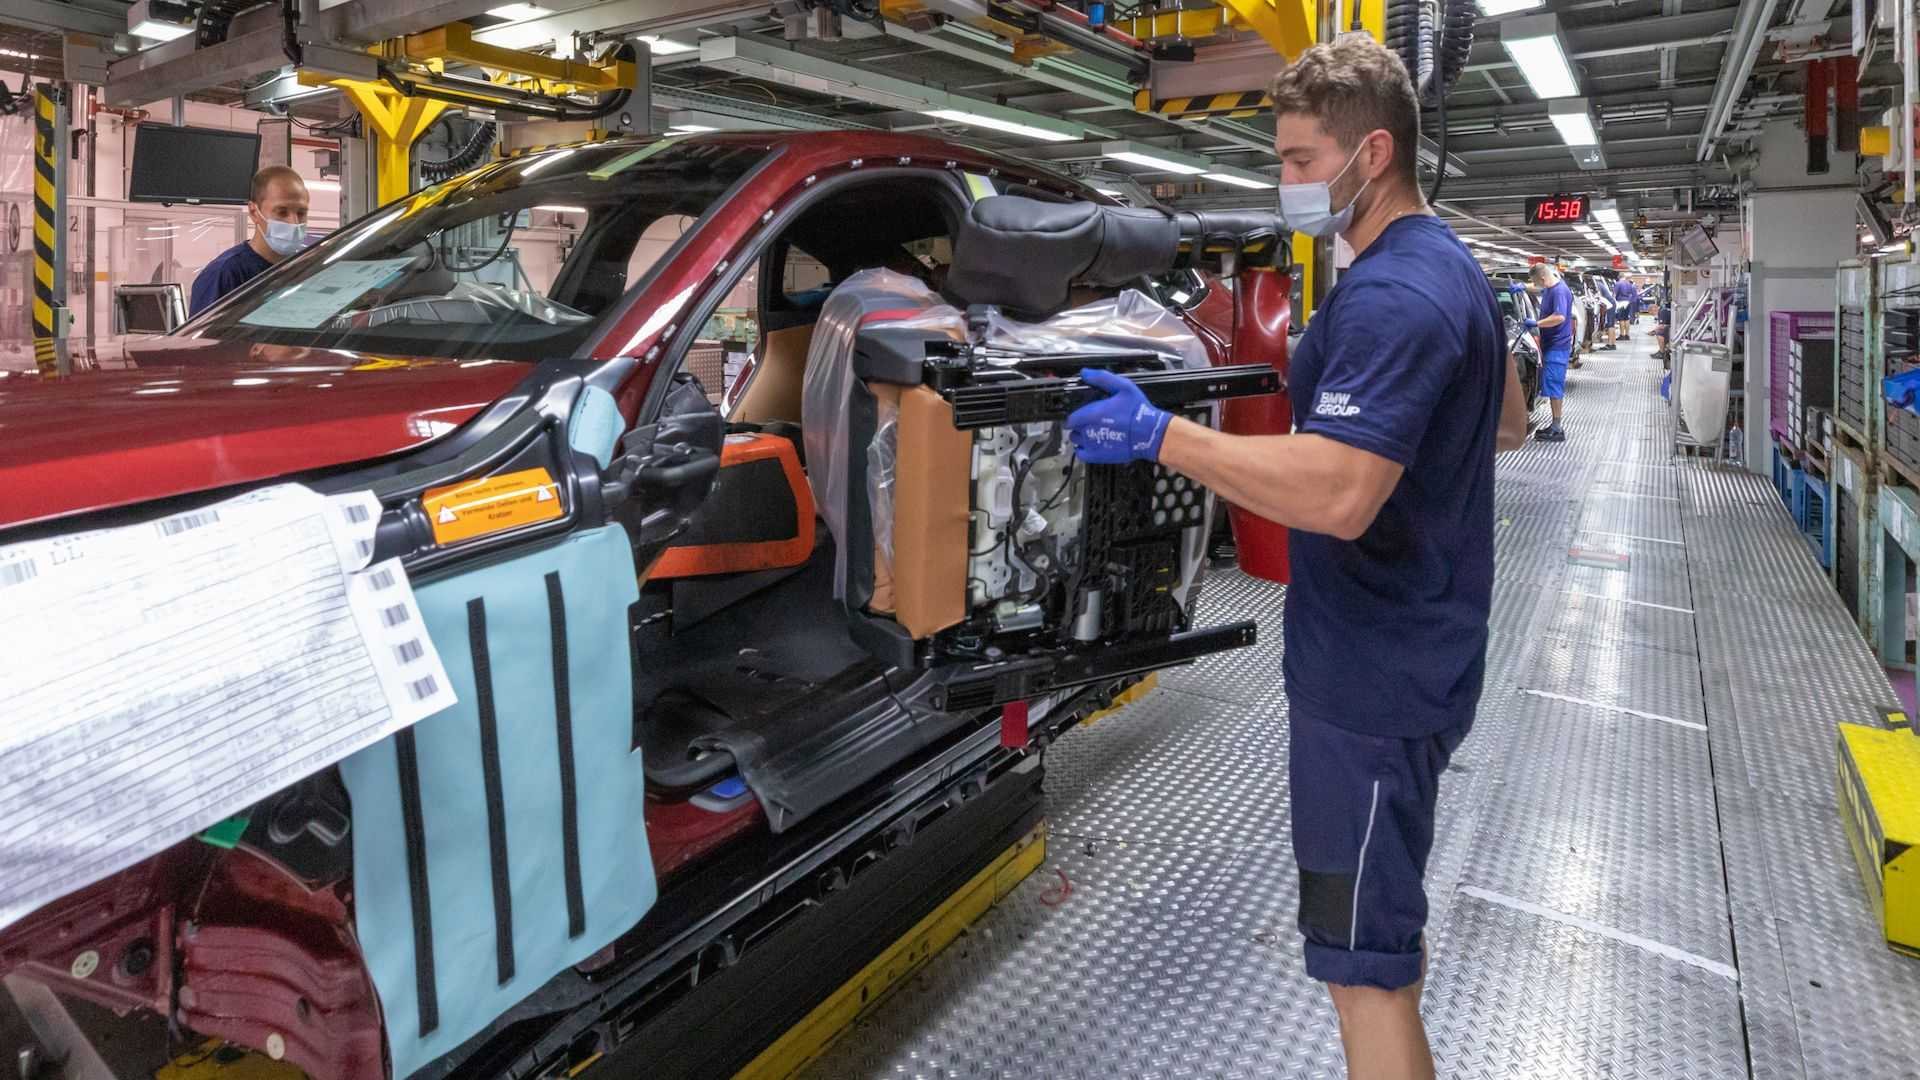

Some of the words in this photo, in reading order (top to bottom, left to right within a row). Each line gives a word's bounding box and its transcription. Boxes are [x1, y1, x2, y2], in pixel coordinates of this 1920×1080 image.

[1538, 200, 1581, 219] 15:38
[1320, 391, 1351, 405] BMW
[1315, 403, 1361, 416] GROUP
